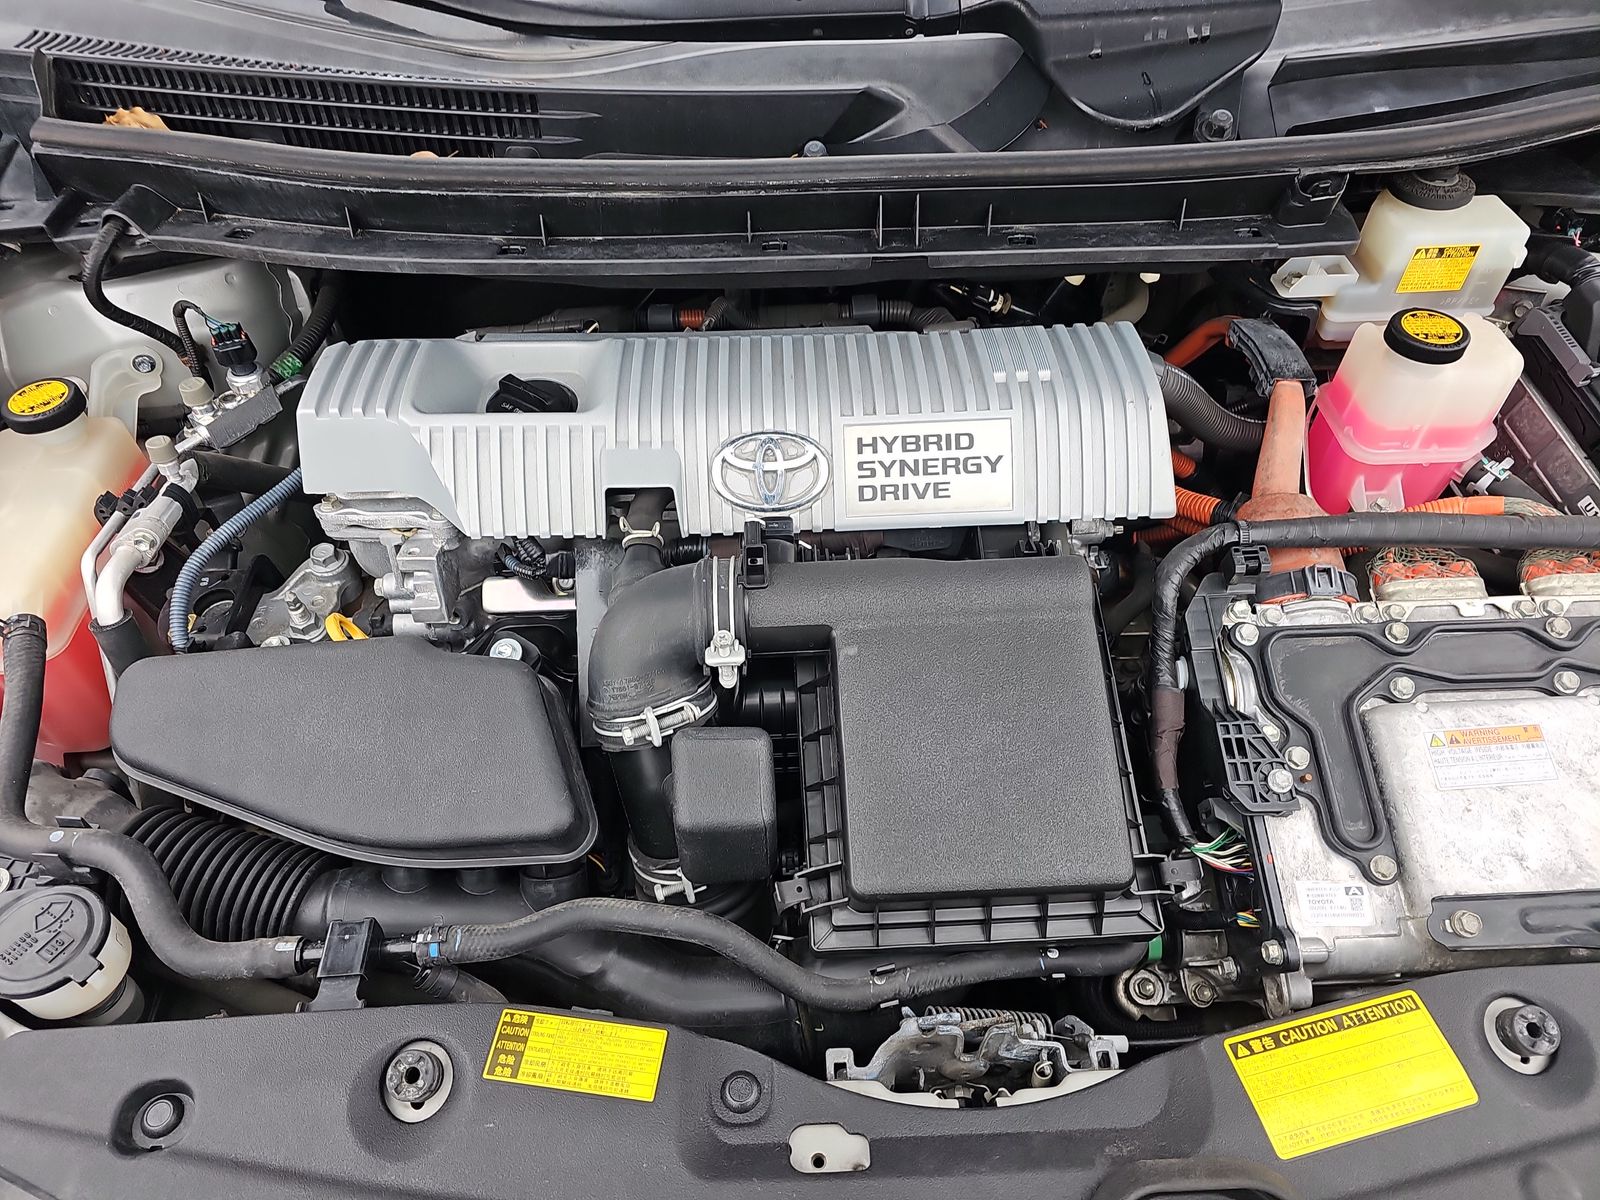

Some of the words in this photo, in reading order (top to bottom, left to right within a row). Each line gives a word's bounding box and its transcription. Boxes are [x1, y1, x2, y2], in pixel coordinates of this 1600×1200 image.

[857, 433, 975, 454] HYBRID
[857, 455, 1004, 479] SYNERGY
[858, 482, 951, 502] DRIVE
[1460, 728, 1500, 738] WARNING
[1463, 734, 1521, 745] AVERTISSEMENT
[512, 1014, 529, 1025] 危険
[1249, 1037, 1276, 1053] 警告
[1279, 1019, 1338, 1045] CAUTION
[1342, 997, 1417, 1029] ATTENTION
[501, 1026, 529, 1037] CAUTION
[496, 1040, 525, 1052] ATTENTION
